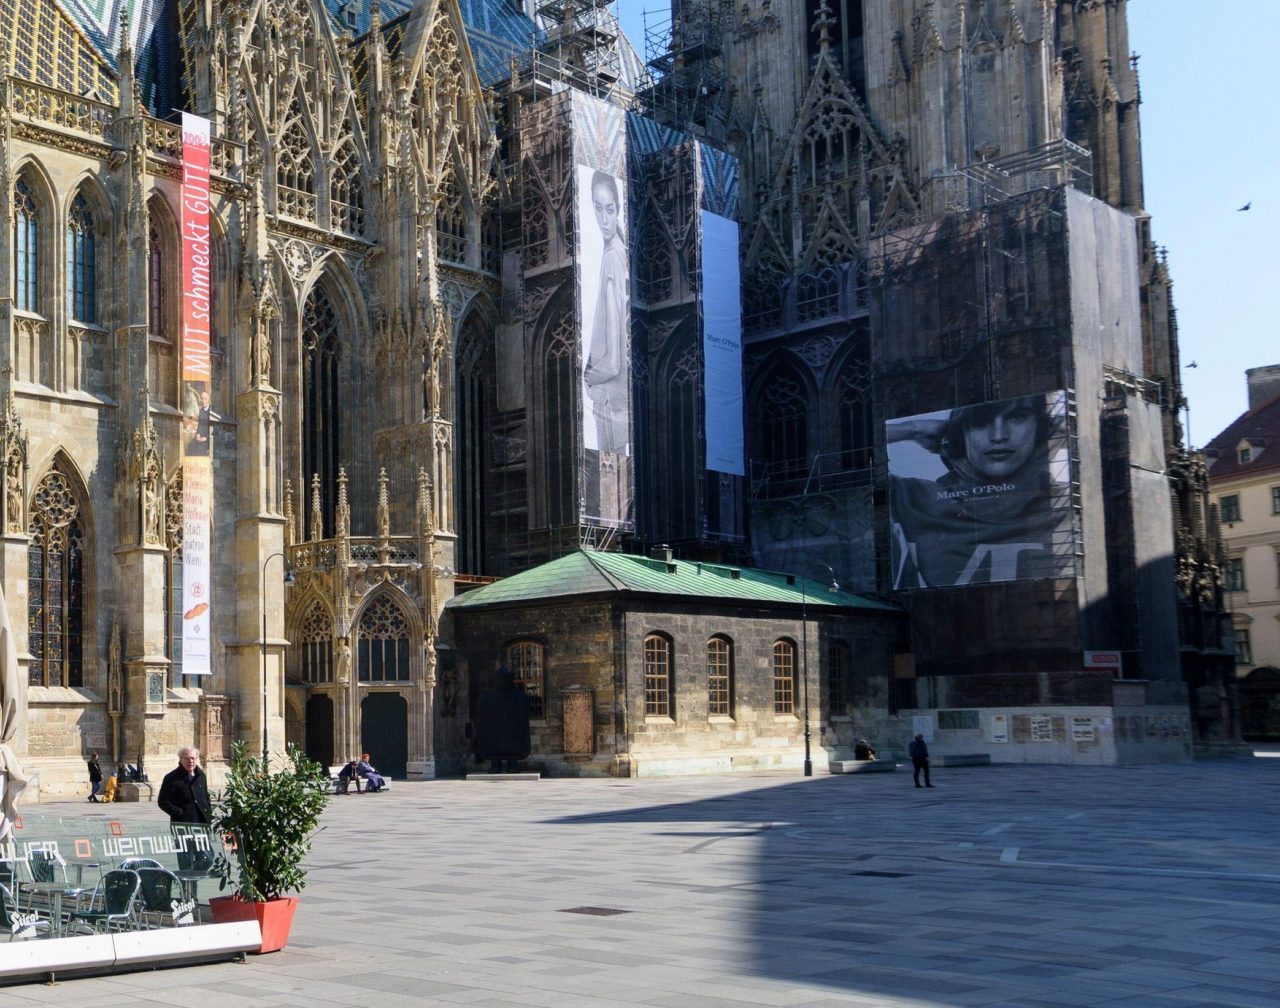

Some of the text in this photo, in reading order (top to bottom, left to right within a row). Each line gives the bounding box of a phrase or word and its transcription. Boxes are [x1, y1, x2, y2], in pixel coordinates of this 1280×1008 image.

[184, 162, 210, 215] GUT!
[184, 220, 210, 322] schmeckt
[183, 323, 210, 375] MUT
[936, 490, 969, 500] Marc
[972, 483, 1016, 495] O'Polo
[102, 834, 211, 857] weinwurm
[11, 910, 40, 934] Stiegl
[171, 899, 197, 922] Stiegl
